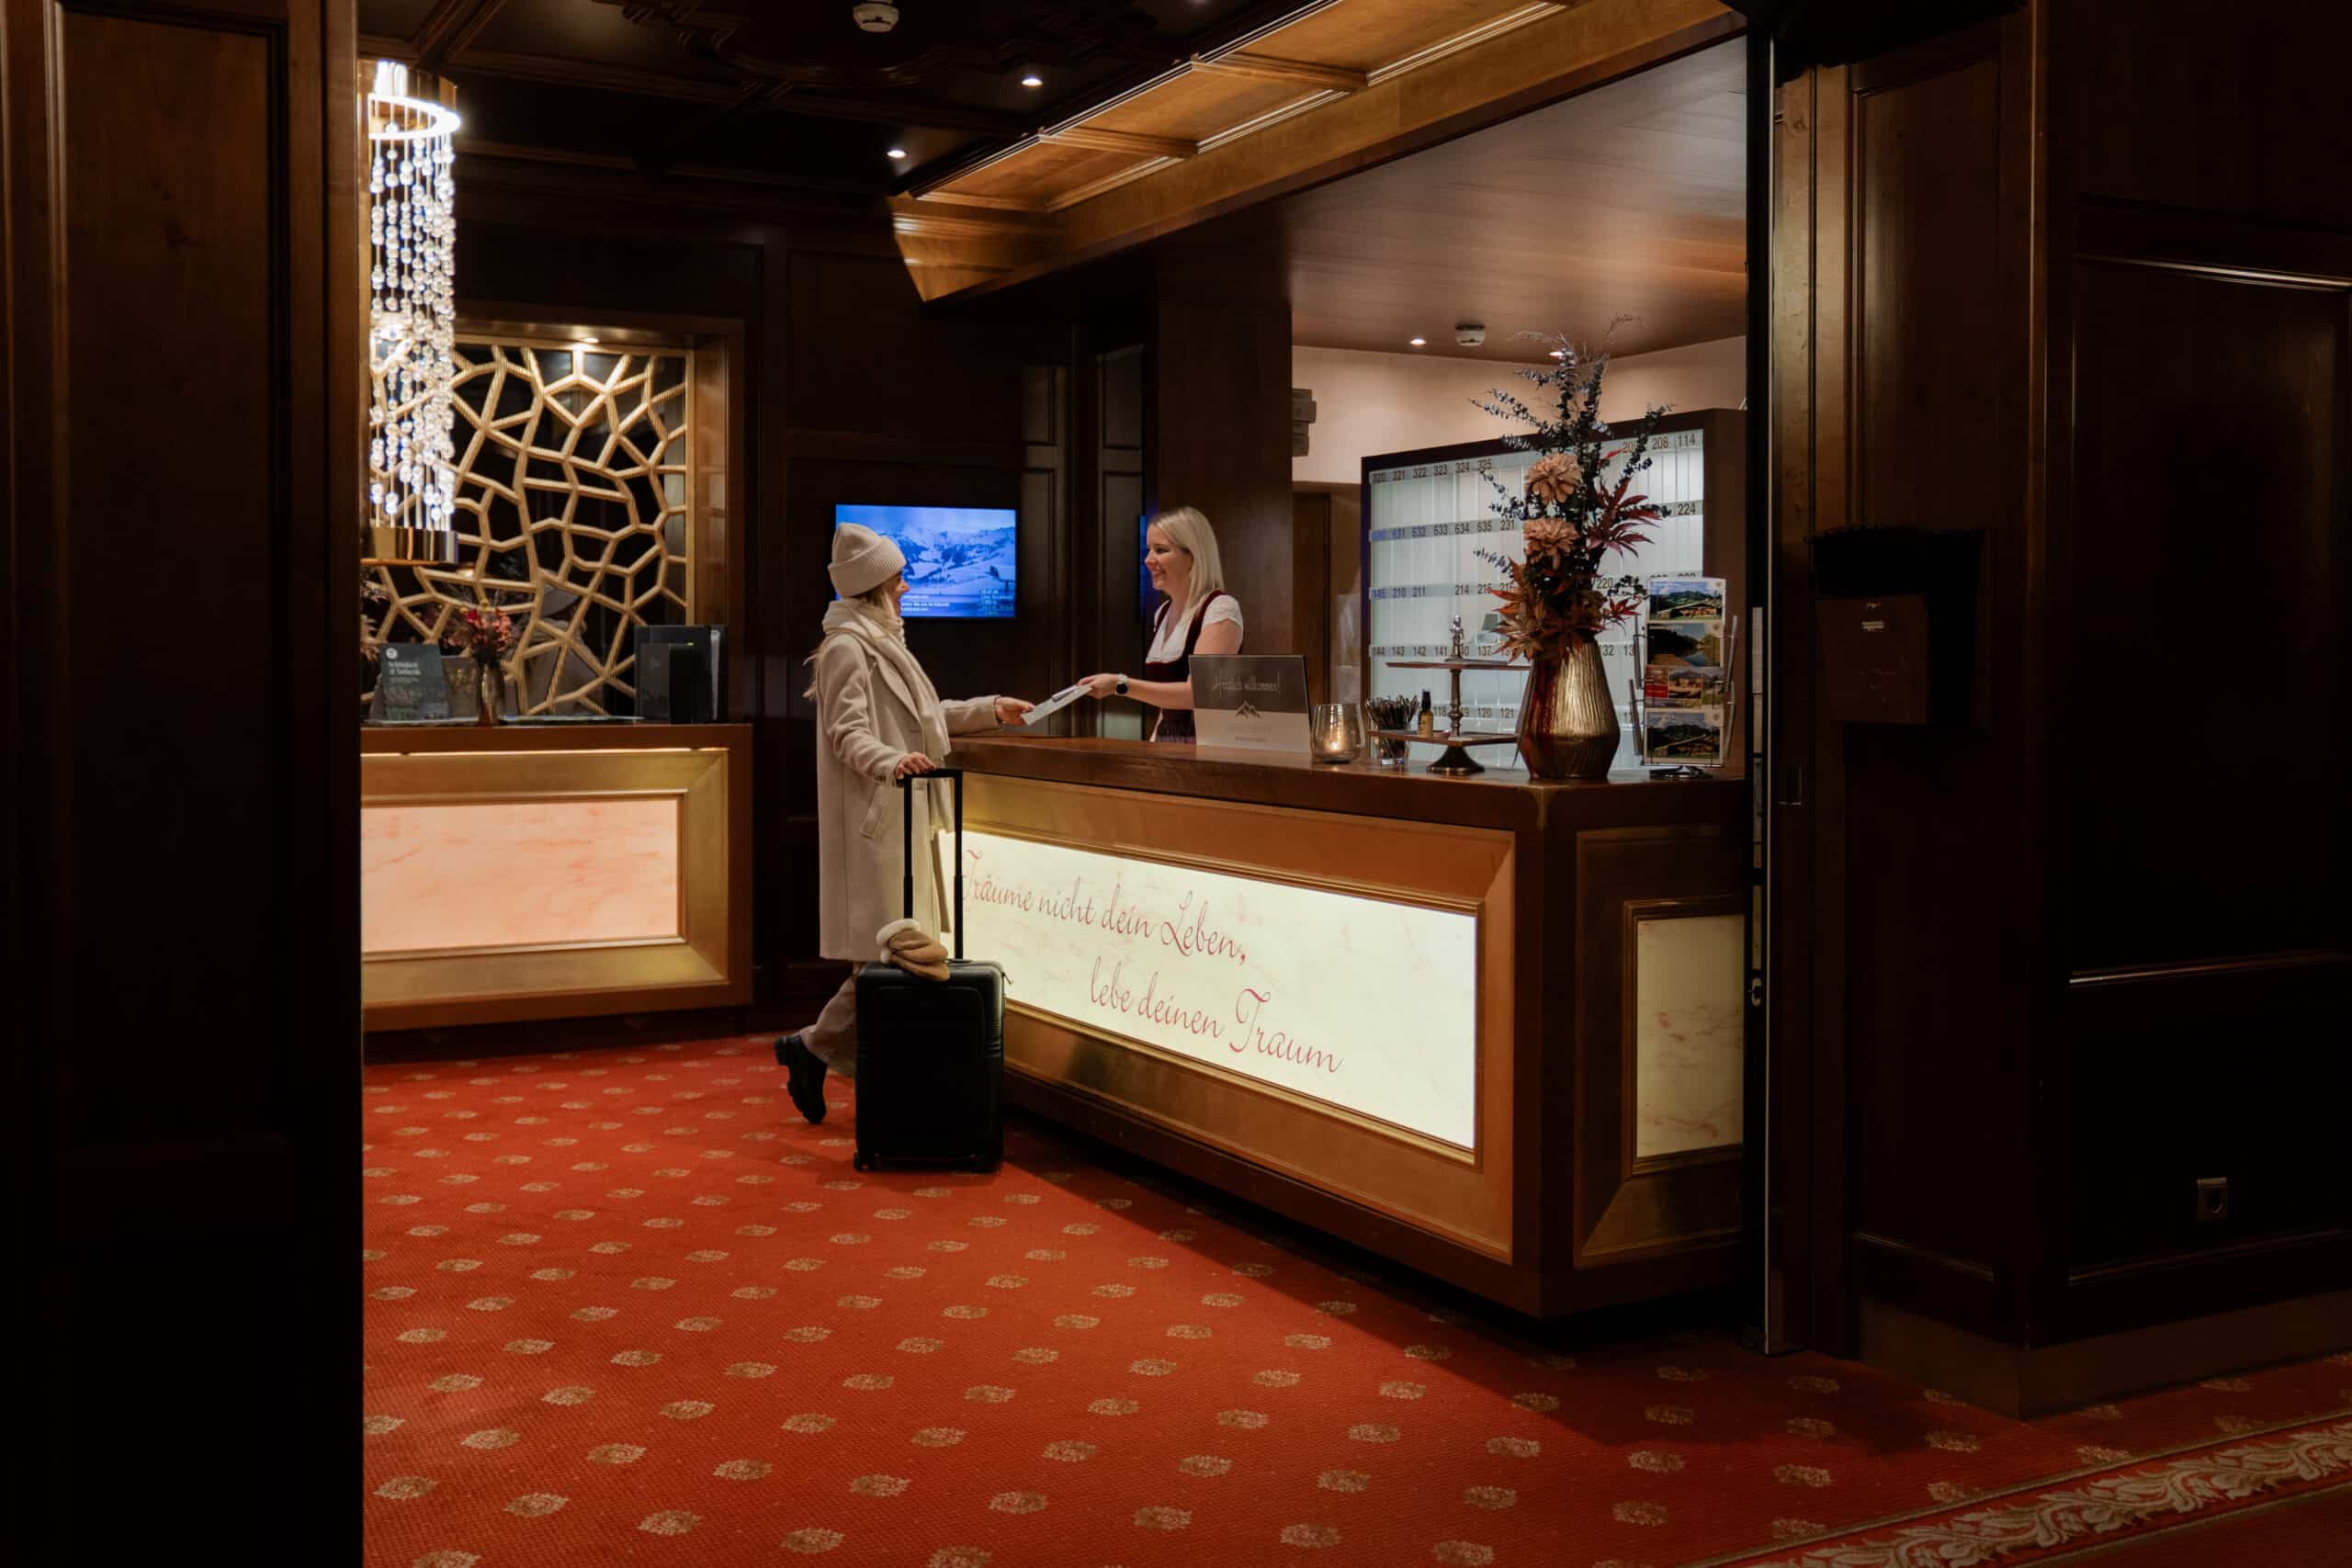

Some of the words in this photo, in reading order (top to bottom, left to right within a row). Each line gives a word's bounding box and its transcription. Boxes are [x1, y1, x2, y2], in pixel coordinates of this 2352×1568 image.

[1392, 471, 1406, 481] 321
[1412, 468, 1427, 479] 322
[1433, 465, 1448, 476] 323
[1455, 462, 1470, 474] 324
[1476, 459, 1493, 470] 325
[1653, 436, 1669, 449] 208
[1678, 434, 1696, 447] 114
[1433, 525, 1448, 536] 633
[1455, 523, 1470, 535] 634
[1476, 521, 1493, 533] 635
[1500, 519, 1515, 531] 231
[1678, 502, 1697, 515] 224
[1392, 588, 1407, 598] 210
[1412, 587, 1426, 597] 211
[1455, 585, 1470, 595] 214
[1598, 578, 1613, 589] 220
[1392, 646, 1406, 656] 143
[1413, 646, 1427, 657] 142
[1435, 646, 1448, 656] 141
[1477, 646, 1493, 656] 137
[1476, 707, 1492, 718] 120
[1500, 707, 1515, 719] 121
[1038, 875, 1096, 926] nicht
[1102, 883, 1155, 938] dein
[1160, 890, 1247, 965] Leben,
[1091, 955, 1133, 1013] lebe
[1137, 970, 1225, 1039] deinen
[1229, 987, 1344, 1074] Traum
